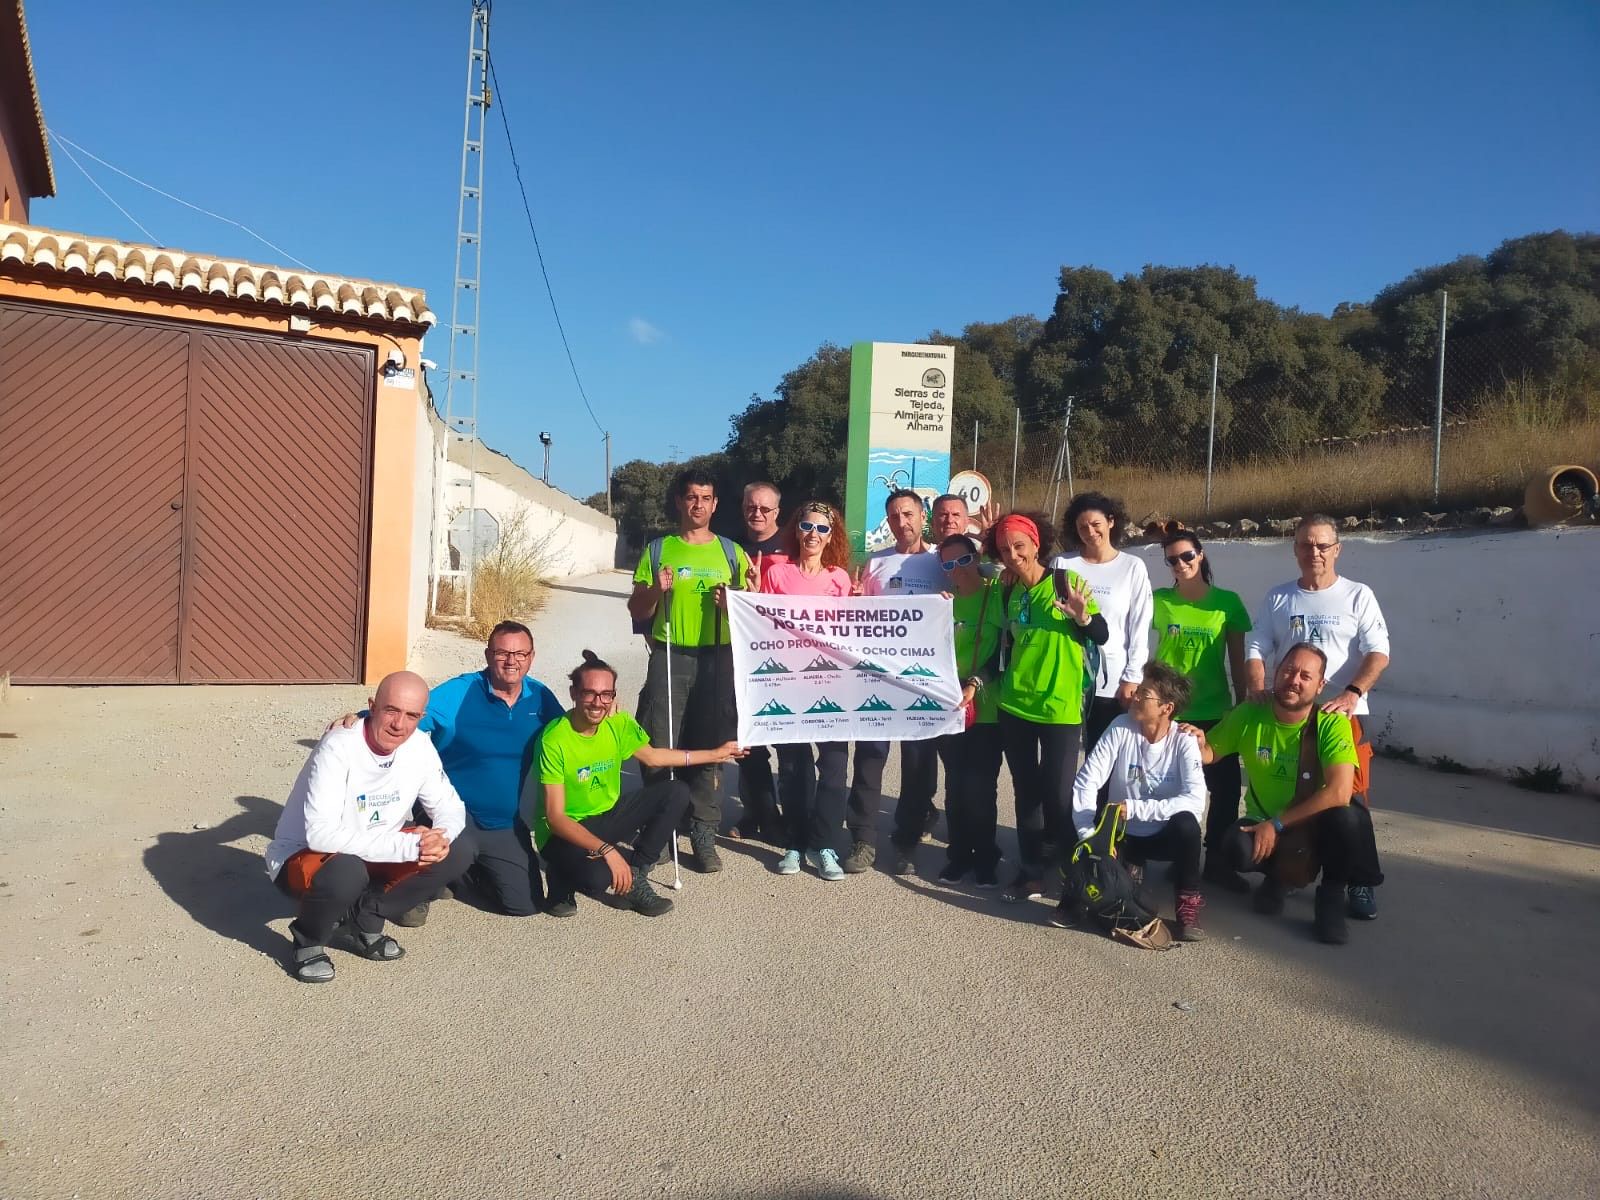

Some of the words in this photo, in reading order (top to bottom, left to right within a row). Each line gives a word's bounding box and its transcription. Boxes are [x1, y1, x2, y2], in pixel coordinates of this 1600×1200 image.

[894, 387, 928, 398] Sierras
[932, 389, 945, 399] de
[910, 400, 945, 411] Tejeda,
[894, 410, 933, 421] Almijara
[937, 414, 944, 422] y
[906, 421, 944, 432] Alhama
[957, 485, 980, 502] 40
[755, 604, 786, 618] QUE
[790, 609, 810, 621] LA
[814, 609, 924, 622] ENFERMEDAD
[773, 618, 795, 631] NO
[829, 625, 850, 637] TU
[854, 625, 908, 638] TECHO
[750, 639, 785, 651] OCHO
[862, 646, 897, 657] OCHO
[900, 647, 936, 657] CIMAS
